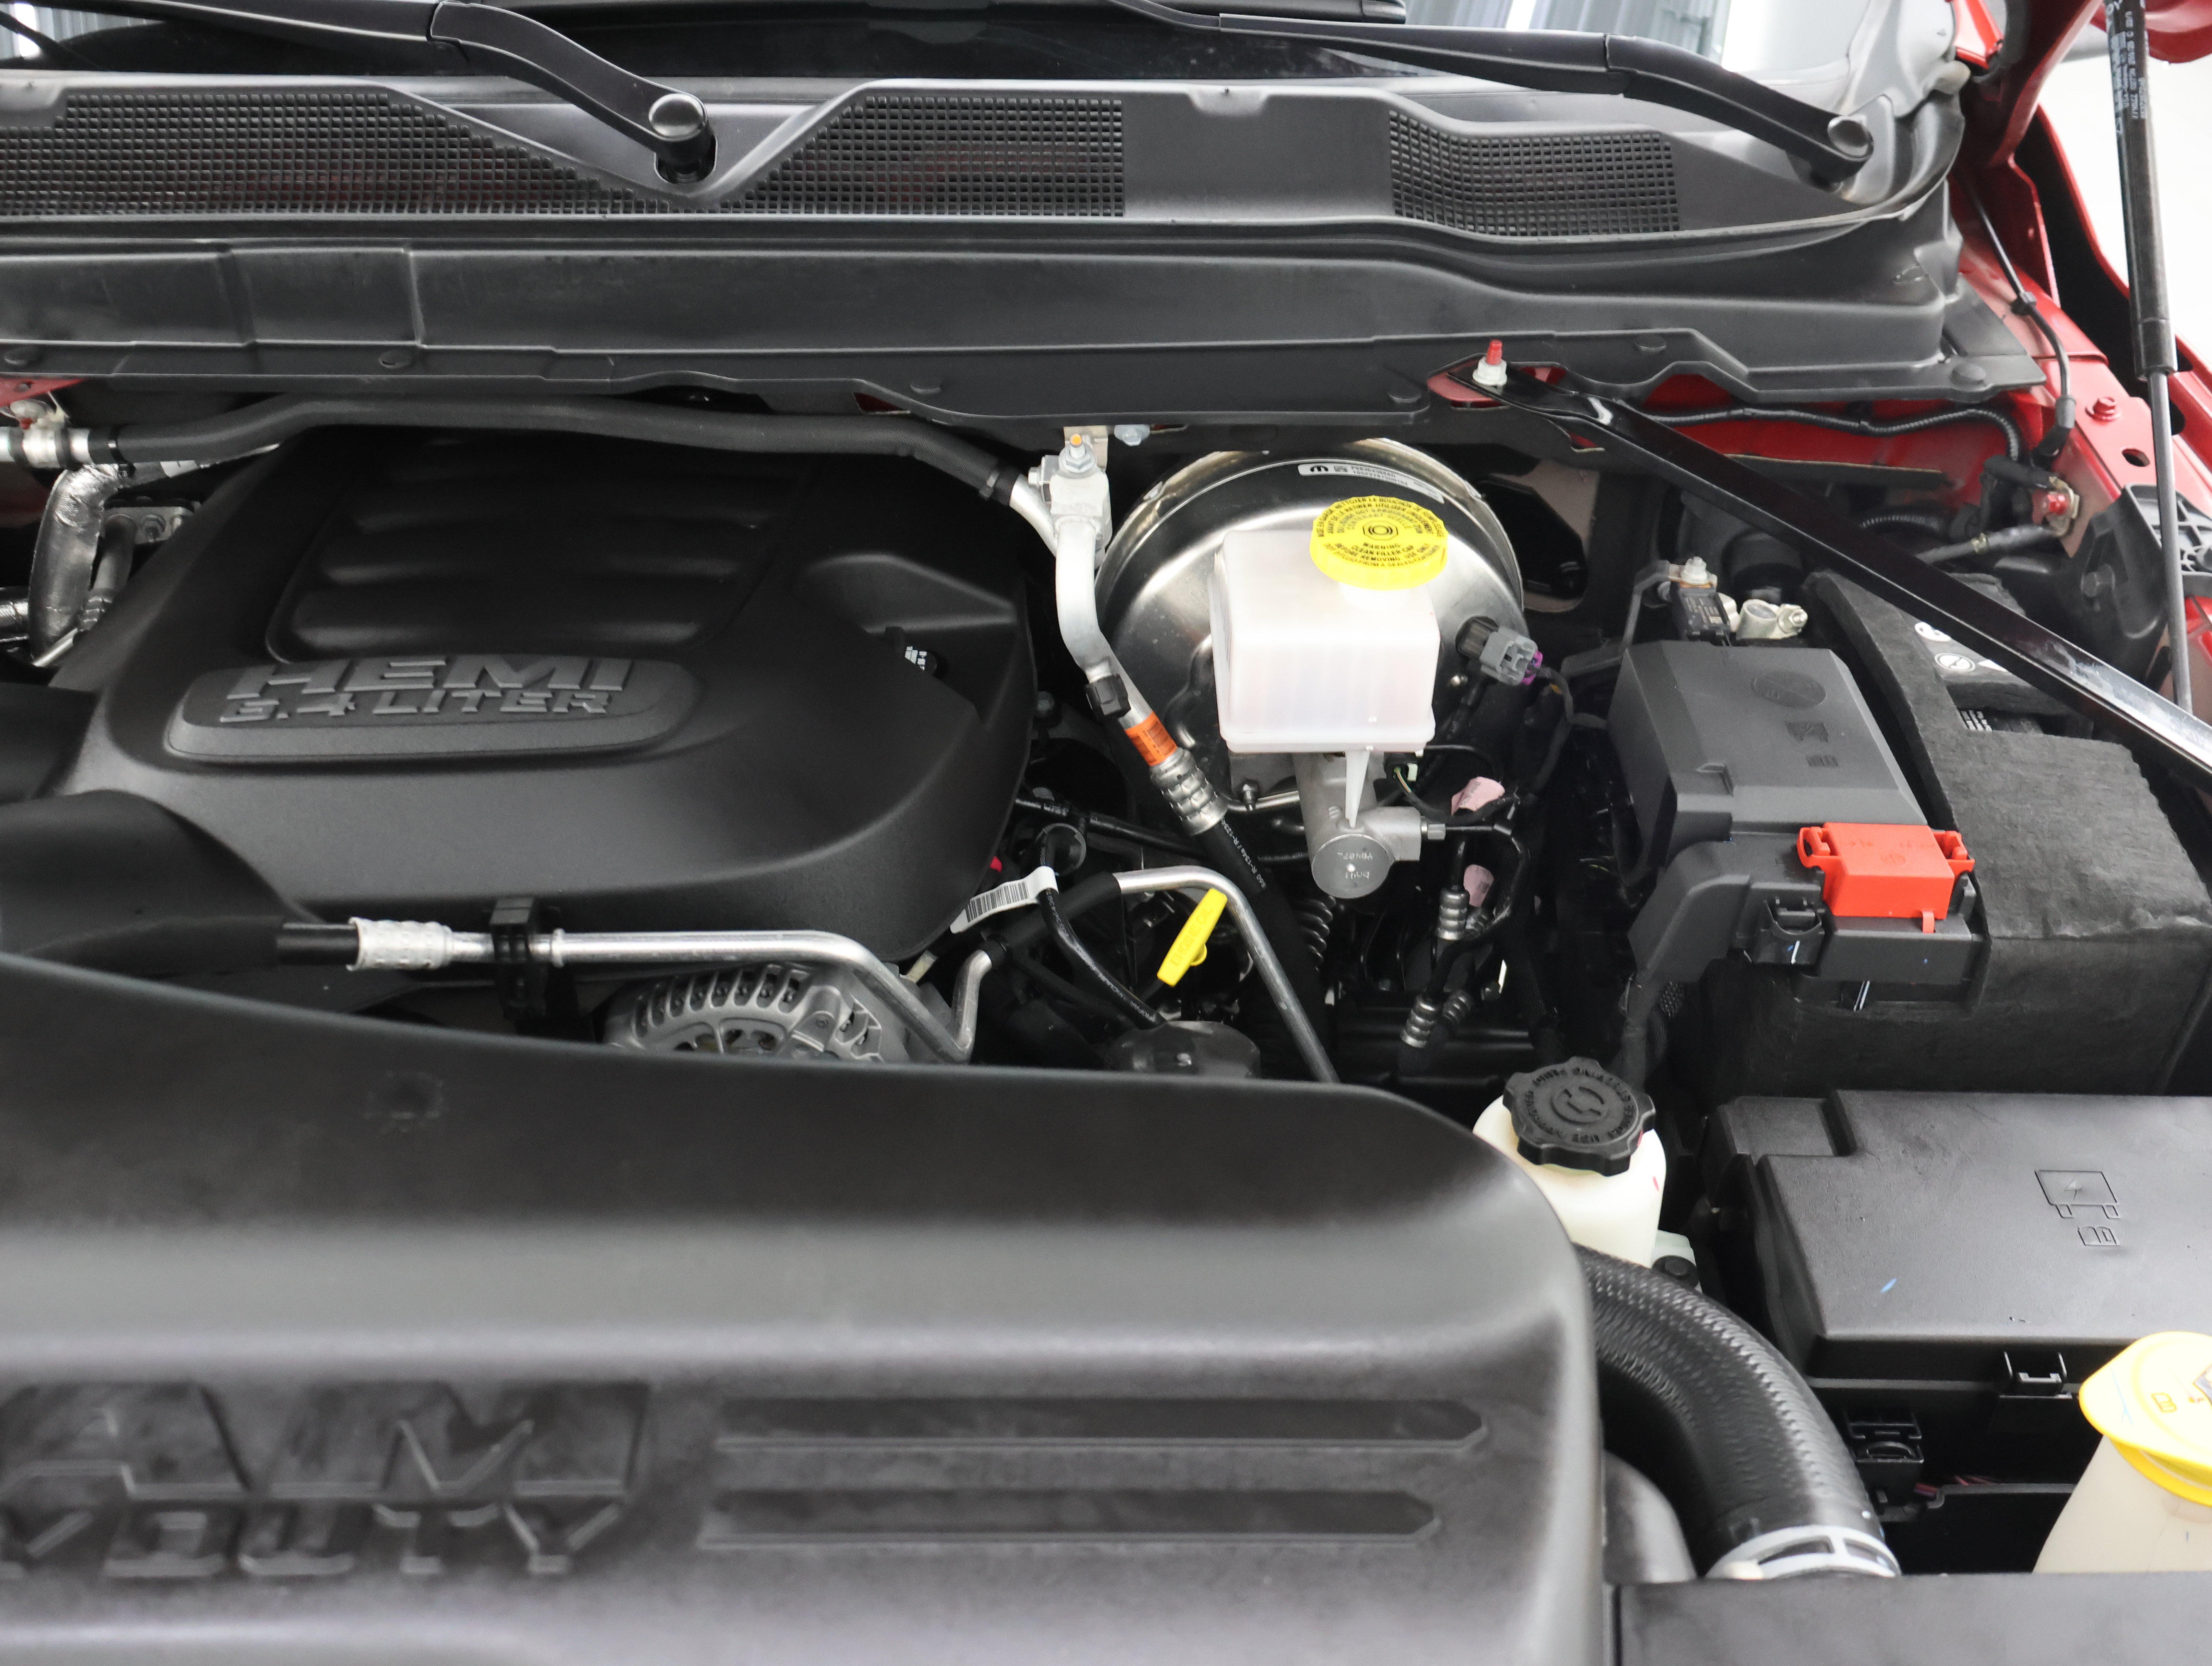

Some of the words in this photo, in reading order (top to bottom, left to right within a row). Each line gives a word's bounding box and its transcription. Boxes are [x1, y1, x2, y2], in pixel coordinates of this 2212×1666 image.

[1334, 497, 1367, 509] NETTOYER
[1379, 497, 1412, 508] BOUCHON
[1423, 511, 1444, 537] REMPLISSAGE
[1375, 503, 1406, 511] UTILISER
[1406, 510, 1434, 535] UNIQUEMENT
[1324, 543, 1336, 551] DOT
[1339, 553, 1358, 562] FLUID
[1414, 545, 1440, 562] CONTAINER
[1335, 543, 1358, 557] BEFORE
[1417, 543, 1431, 553] ONLY
[1351, 545, 1374, 555] CLEAN
[227, 656, 634, 700] HEMI
[220, 692, 356, 722] 6.4
[372, 690, 610, 714] LITER
[1170, 924, 1202, 966] ENGINE
[1196, 908, 1214, 924] OIL
[103, 1500, 624, 1578] DUTY
